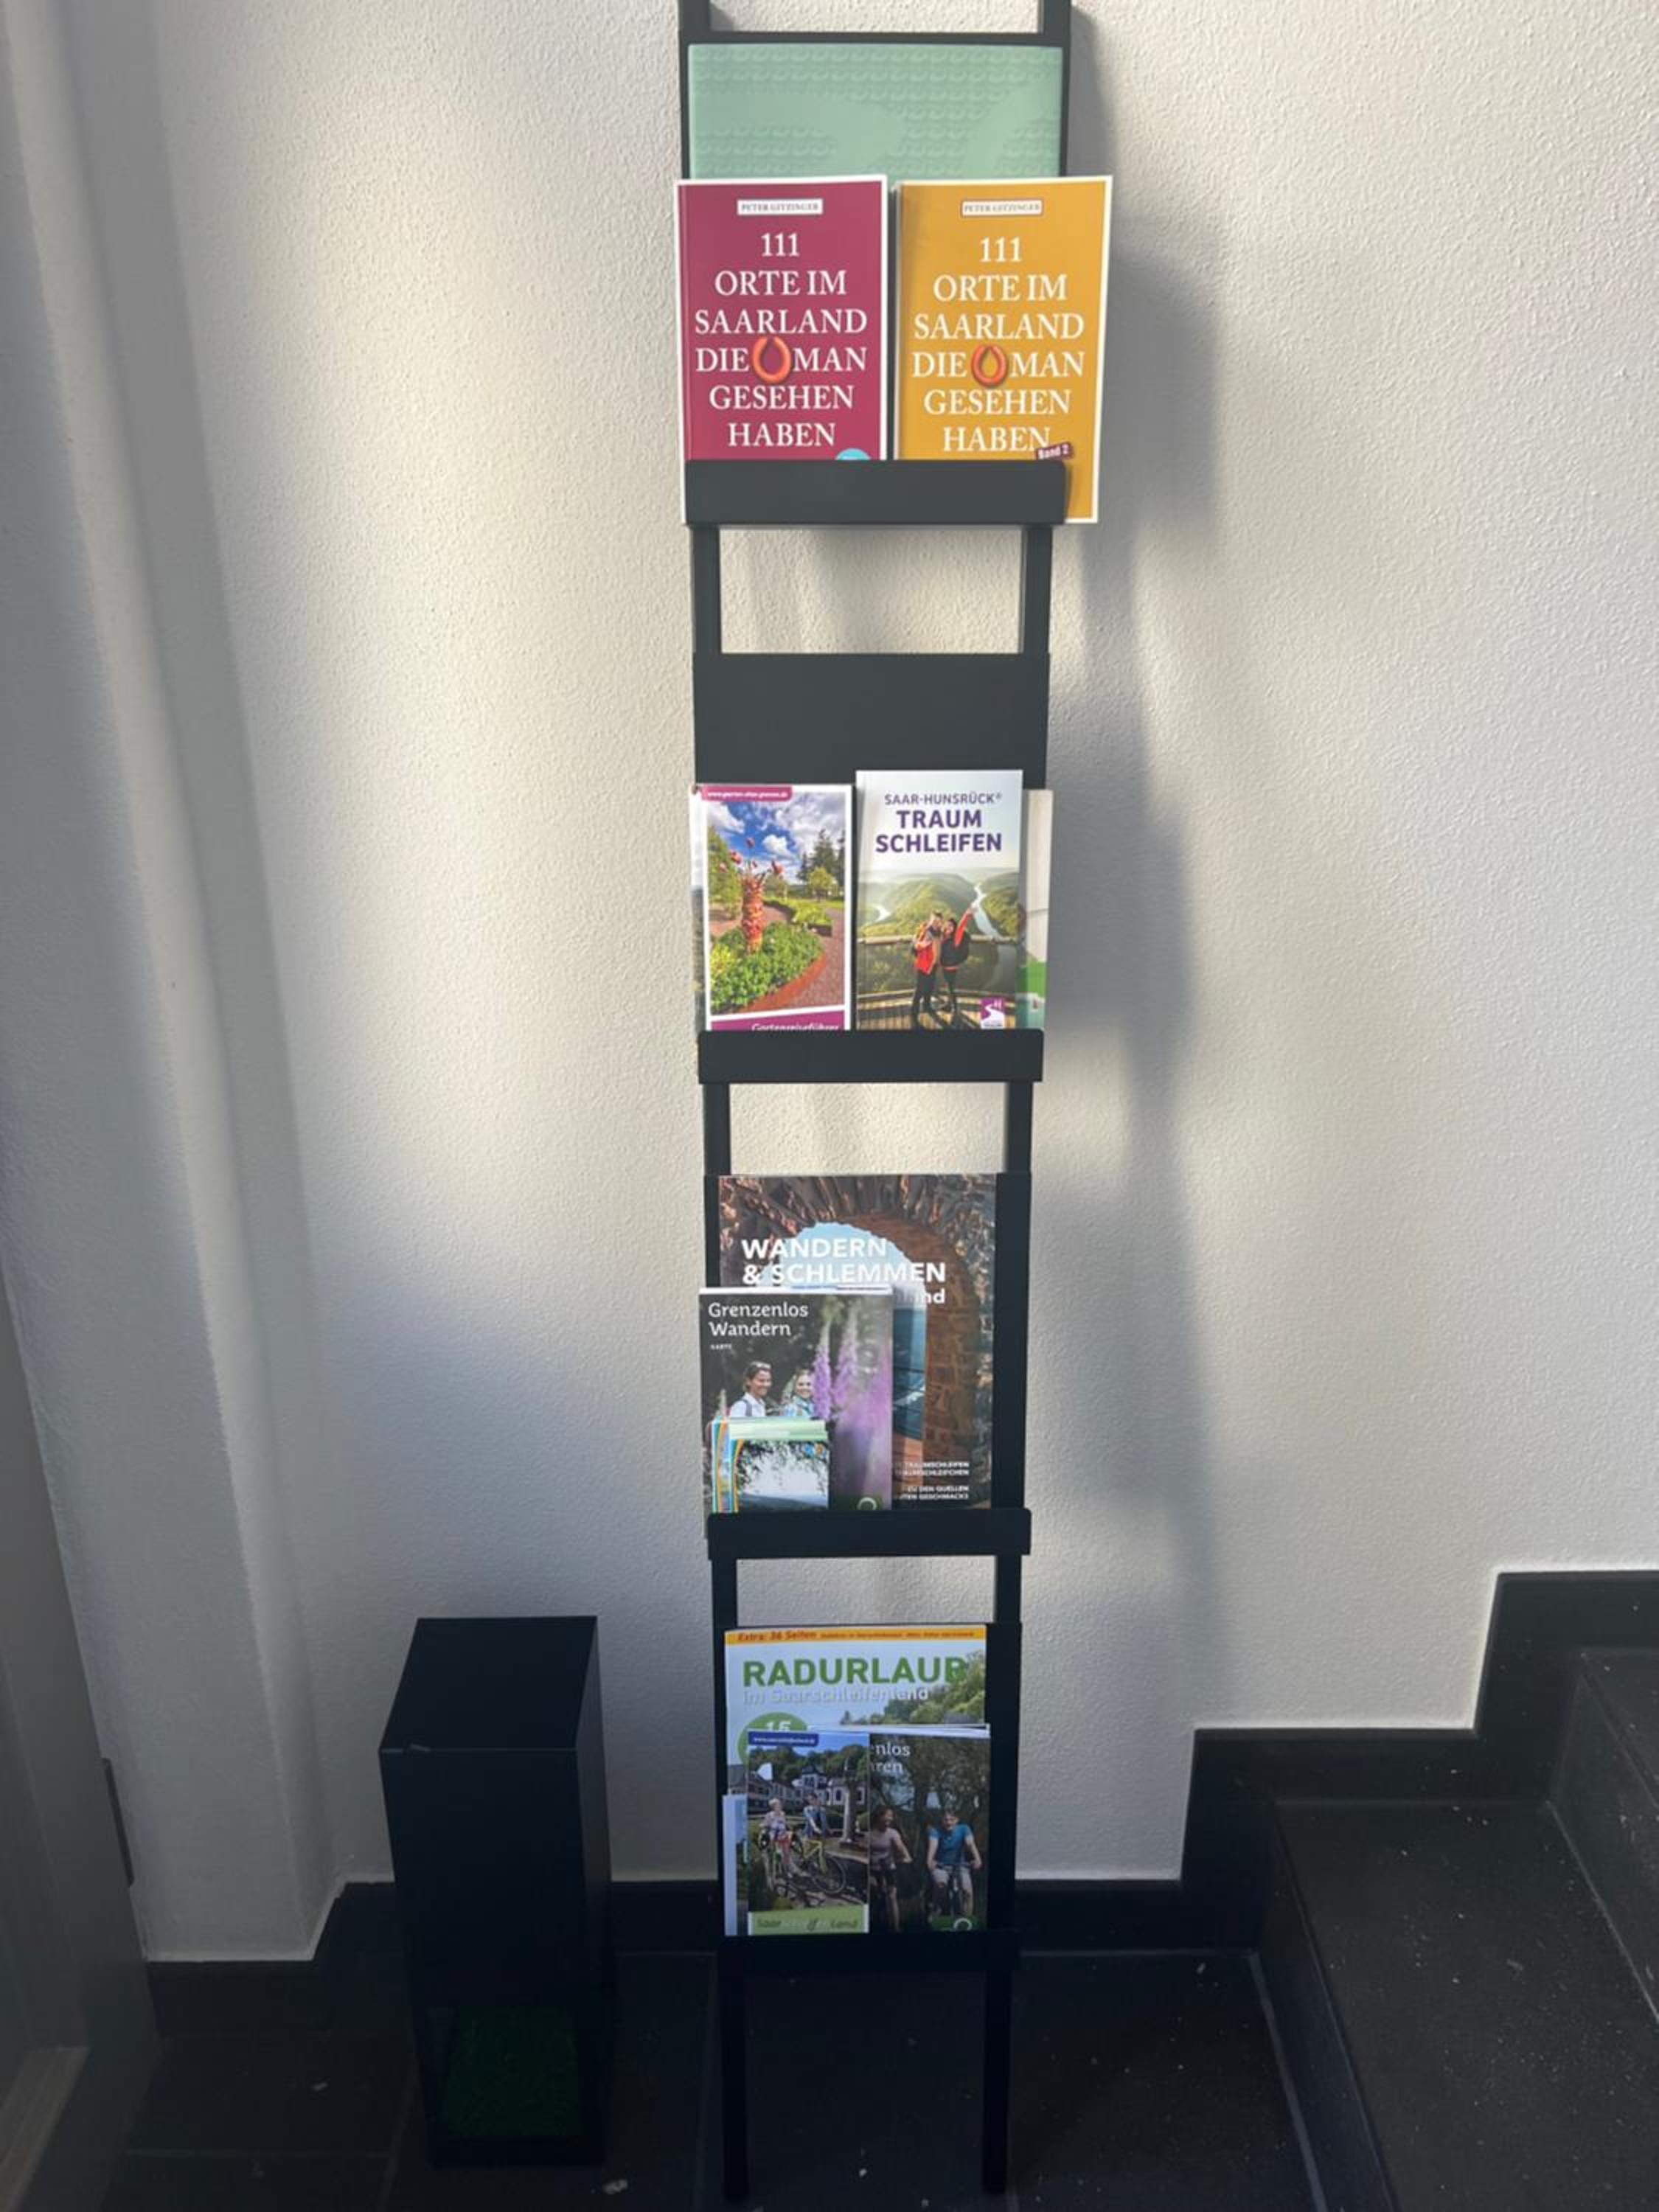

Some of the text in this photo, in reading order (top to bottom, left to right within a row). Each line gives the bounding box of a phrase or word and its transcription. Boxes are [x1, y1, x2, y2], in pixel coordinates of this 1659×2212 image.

[761, 233, 800, 257] 111
[980, 237, 1023, 262] 111
[714, 270, 846, 296] ORTE IM
[933, 274, 1067, 302] ORTE IM
[695, 308, 867, 335] SAARLAND
[914, 313, 1084, 340] SAARLAND
[696, 347, 866, 372] DIE MAN
[912, 352, 1085, 378] DIE MAN
[709, 385, 854, 410] GESEHEN
[924, 389, 1072, 415] GESEHEN
[728, 422, 836, 447] HABEN
[943, 426, 1051, 452] HABEN
[1038, 444, 1069, 459] Band 2
[897, 810, 982, 829] TRAUM
[875, 833, 1001, 853] SCHLEIFEN
[742, 1238, 886, 1259] WANDERN
[742, 1262, 946, 1284] & SCHLEMMEN
[709, 1302, 809, 1318] Grenzenlos
[709, 1321, 791, 1337] Wandern
[738, 1632, 768, 1641] Extra:
[785, 1630, 816, 1640] Seiten
[742, 1656, 967, 1688] RADURLAUB
